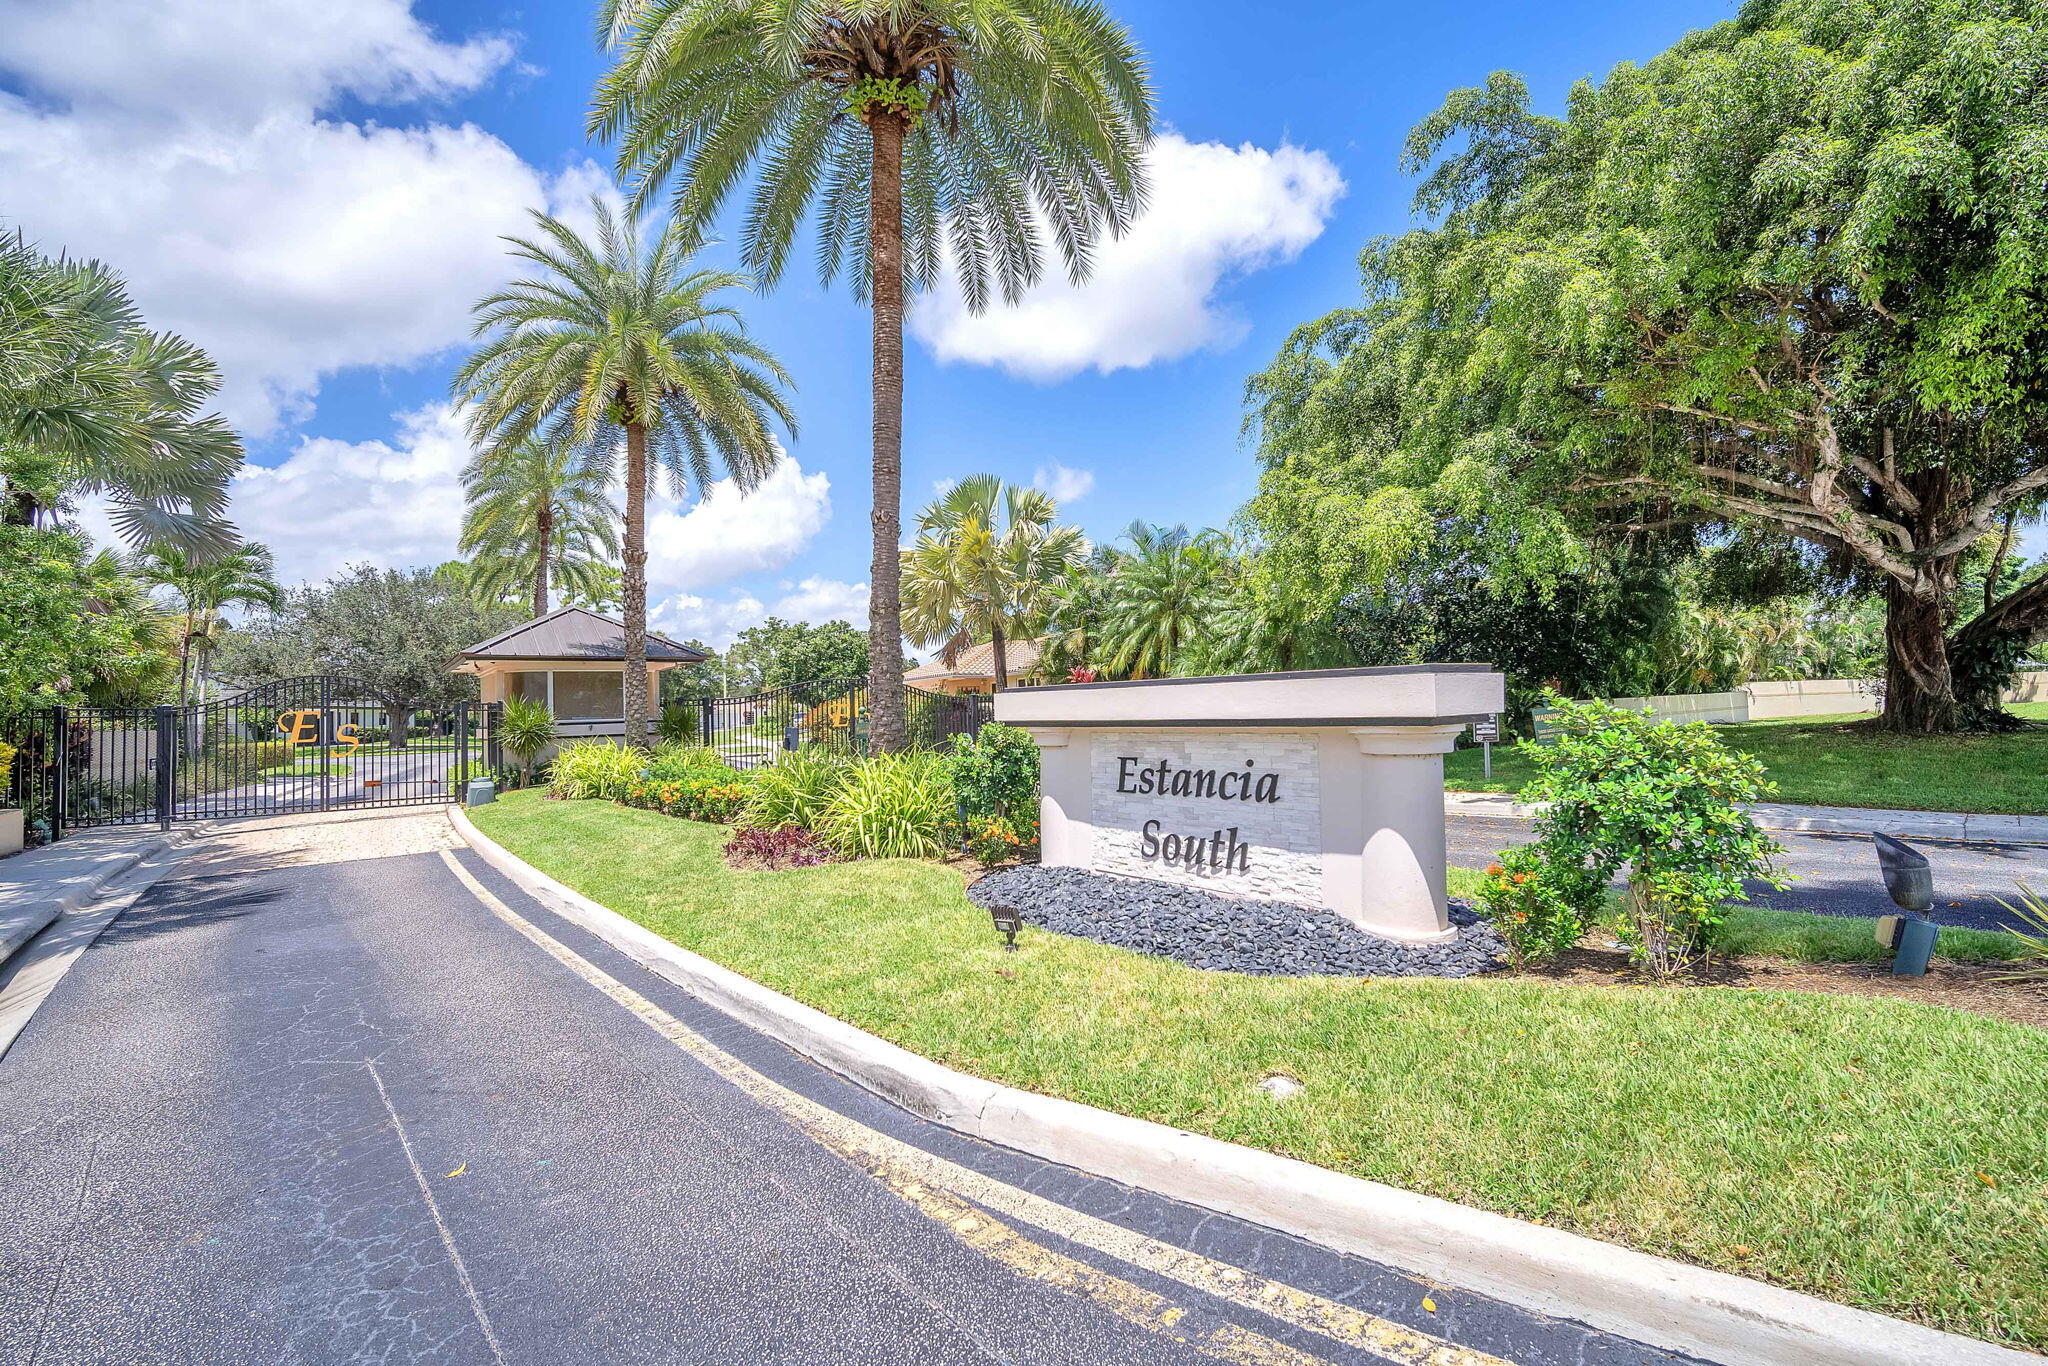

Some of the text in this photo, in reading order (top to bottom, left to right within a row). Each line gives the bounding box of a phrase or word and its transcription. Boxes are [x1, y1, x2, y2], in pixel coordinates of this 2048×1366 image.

[277, 710, 359, 758] E S
[1117, 756, 1281, 804] Estancia
[1141, 819, 1250, 872] South
